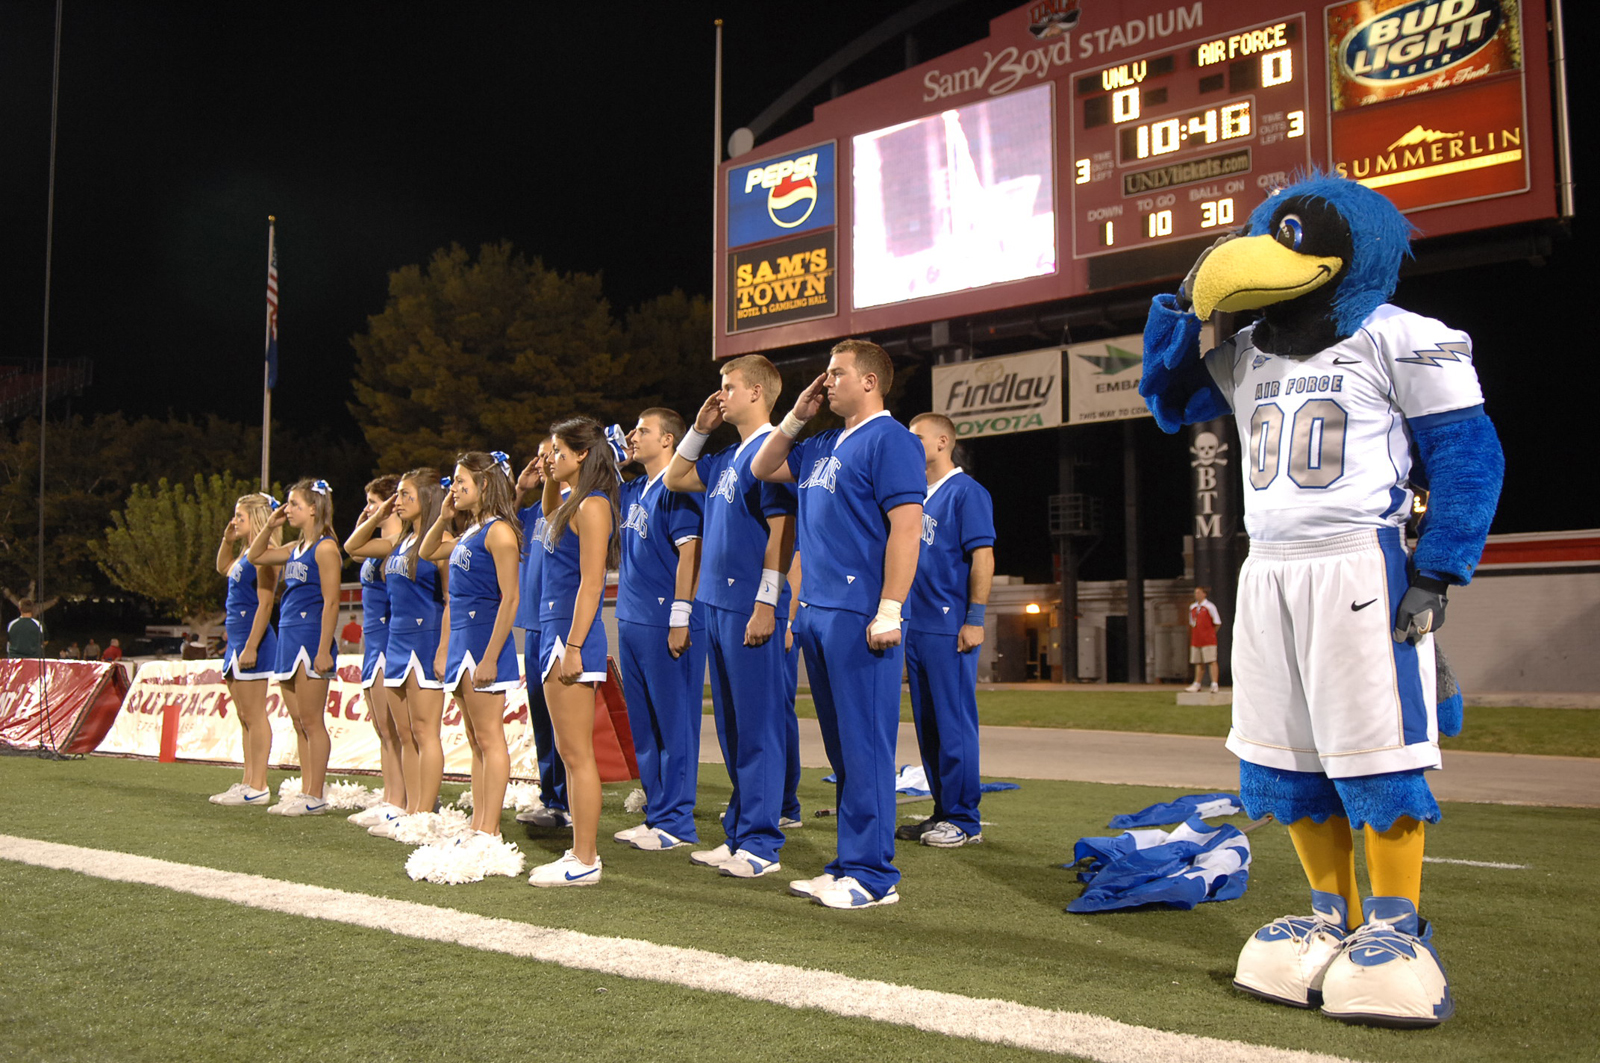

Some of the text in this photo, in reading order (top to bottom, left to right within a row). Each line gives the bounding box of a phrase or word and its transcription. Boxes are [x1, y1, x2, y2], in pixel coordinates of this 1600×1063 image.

[1367, 0, 1476, 47] BUD
[923, 2, 1203, 102] Sam Boyd STADIUM
[1198, 23, 1287, 67] AIR FORCE
[1353, 10, 1491, 75] LIGHT
[1102, 60, 1147, 91] UNLV
[1261, 49, 1292, 87] 0
[1112, 86, 1140, 124] 0
[1262, 111, 1284, 124] TIME
[1137, 102, 1250, 159] 10:46
[1259, 121, 1286, 135] OUTS
[1260, 132, 1284, 146] LEFT
[1287, 110, 1304, 139] 3
[1335, 127, 1521, 179] SUMMERLIN
[745, 153, 818, 193] PEPSI
[1075, 158, 1091, 185] 3
[1126, 154, 1249, 194] UNLVtickets.com
[1137, 194, 1176, 211] TO GO
[1189, 180, 1245, 201] BALL ON
[1087, 205, 1123, 223] DOWN
[1149, 210, 1172, 238] 10
[1200, 198, 1234, 228] 30
[1105, 221, 1114, 246] 1
[737, 247, 827, 288] SAM'S
[737, 271, 829, 309] TOWN
[737, 306, 760, 319] HOTEL
[769, 297, 807, 313] GAMBLING
[808, 294, 828, 306] HALL
[945, 373, 1056, 411] Findlay
[1096, 379, 1140, 394] EMBA
[1254, 375, 1344, 401] AIR FORCE
[954, 413, 1044, 436] OYOTA
[1249, 398, 1348, 491] 00
